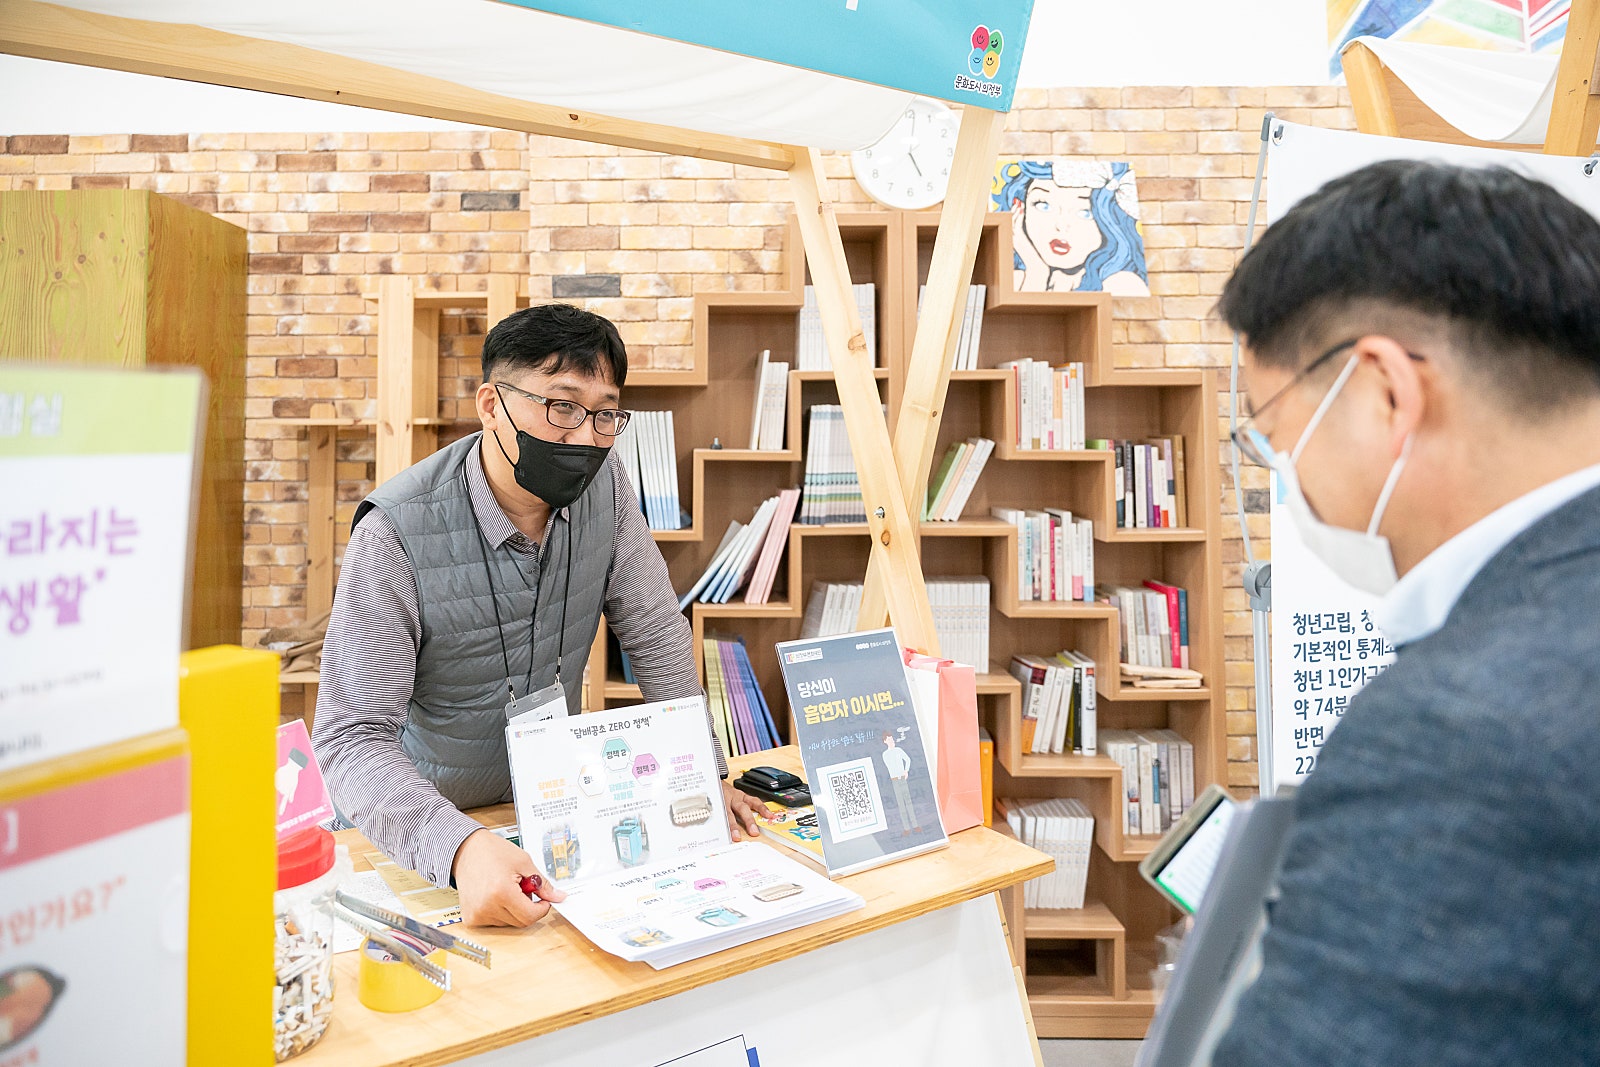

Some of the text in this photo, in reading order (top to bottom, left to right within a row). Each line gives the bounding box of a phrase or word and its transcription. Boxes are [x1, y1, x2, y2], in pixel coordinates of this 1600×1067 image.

[954, 75, 981, 92] 문화도시
[941, 128, 948, 138] 2
[866, 150, 873, 159] 9
[947, 147, 954, 157] 3
[872, 169, 879, 179] 8
[941, 167, 948, 176] 4
[887, 182, 894, 192] 7
[907, 187, 914, 197] 6
[926, 182, 934, 192] 5
[0, 506, 138, 555] 라지는
[1293, 611, 1356, 635] 청년고립,
[1293, 639, 1351, 663] 기본적인
[1293, 669, 1323, 693] 청년
[797, 678, 836, 698] 당신이
[803, 698, 849, 725] 흡연자
[1293, 699, 1310, 720] 약
[608, 720, 631, 732] ZERO
[1294, 726, 1325, 749] 반면
[606, 749, 627, 759] 정책 2
[636, 764, 656, 774] 정책 3
[651, 868, 677, 878] ZERO
